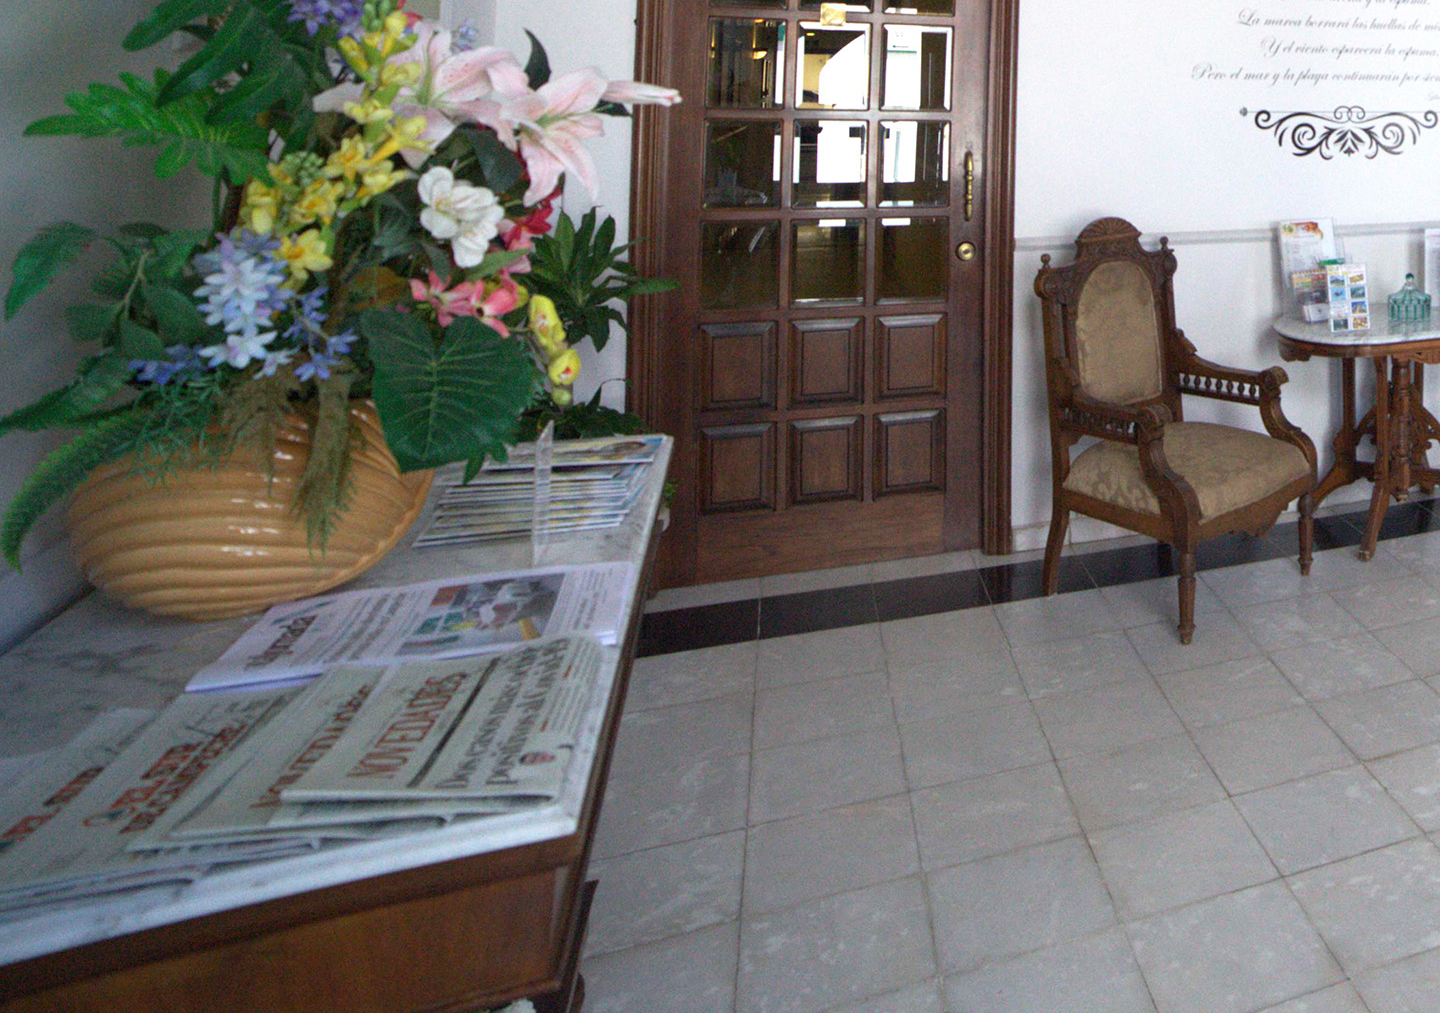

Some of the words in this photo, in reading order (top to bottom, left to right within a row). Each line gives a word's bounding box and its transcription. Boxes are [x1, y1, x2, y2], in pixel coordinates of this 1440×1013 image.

[1237, 8, 1261, 27] La
[1264, 18, 1302, 27] marea
[1352, 16, 1368, 30] las
[1369, 18, 1406, 31] huellas
[1407, 19, 1421, 31] de
[1261, 36, 1283, 59] Y
[1282, 40, 1296, 53] el
[1295, 43, 1329, 54] viento
[1385, 42, 1397, 55] la
[1191, 62, 1227, 80] Pero
[1228, 67, 1243, 80] el
[1243, 72, 1270, 81] mar
[1269, 72, 1281, 87] y
[1283, 67, 1295, 80] la
[1293, 67, 1329, 86] playa
[1399, 72, 1420, 87] por
[346, 671, 469, 778] NOVEDADES
